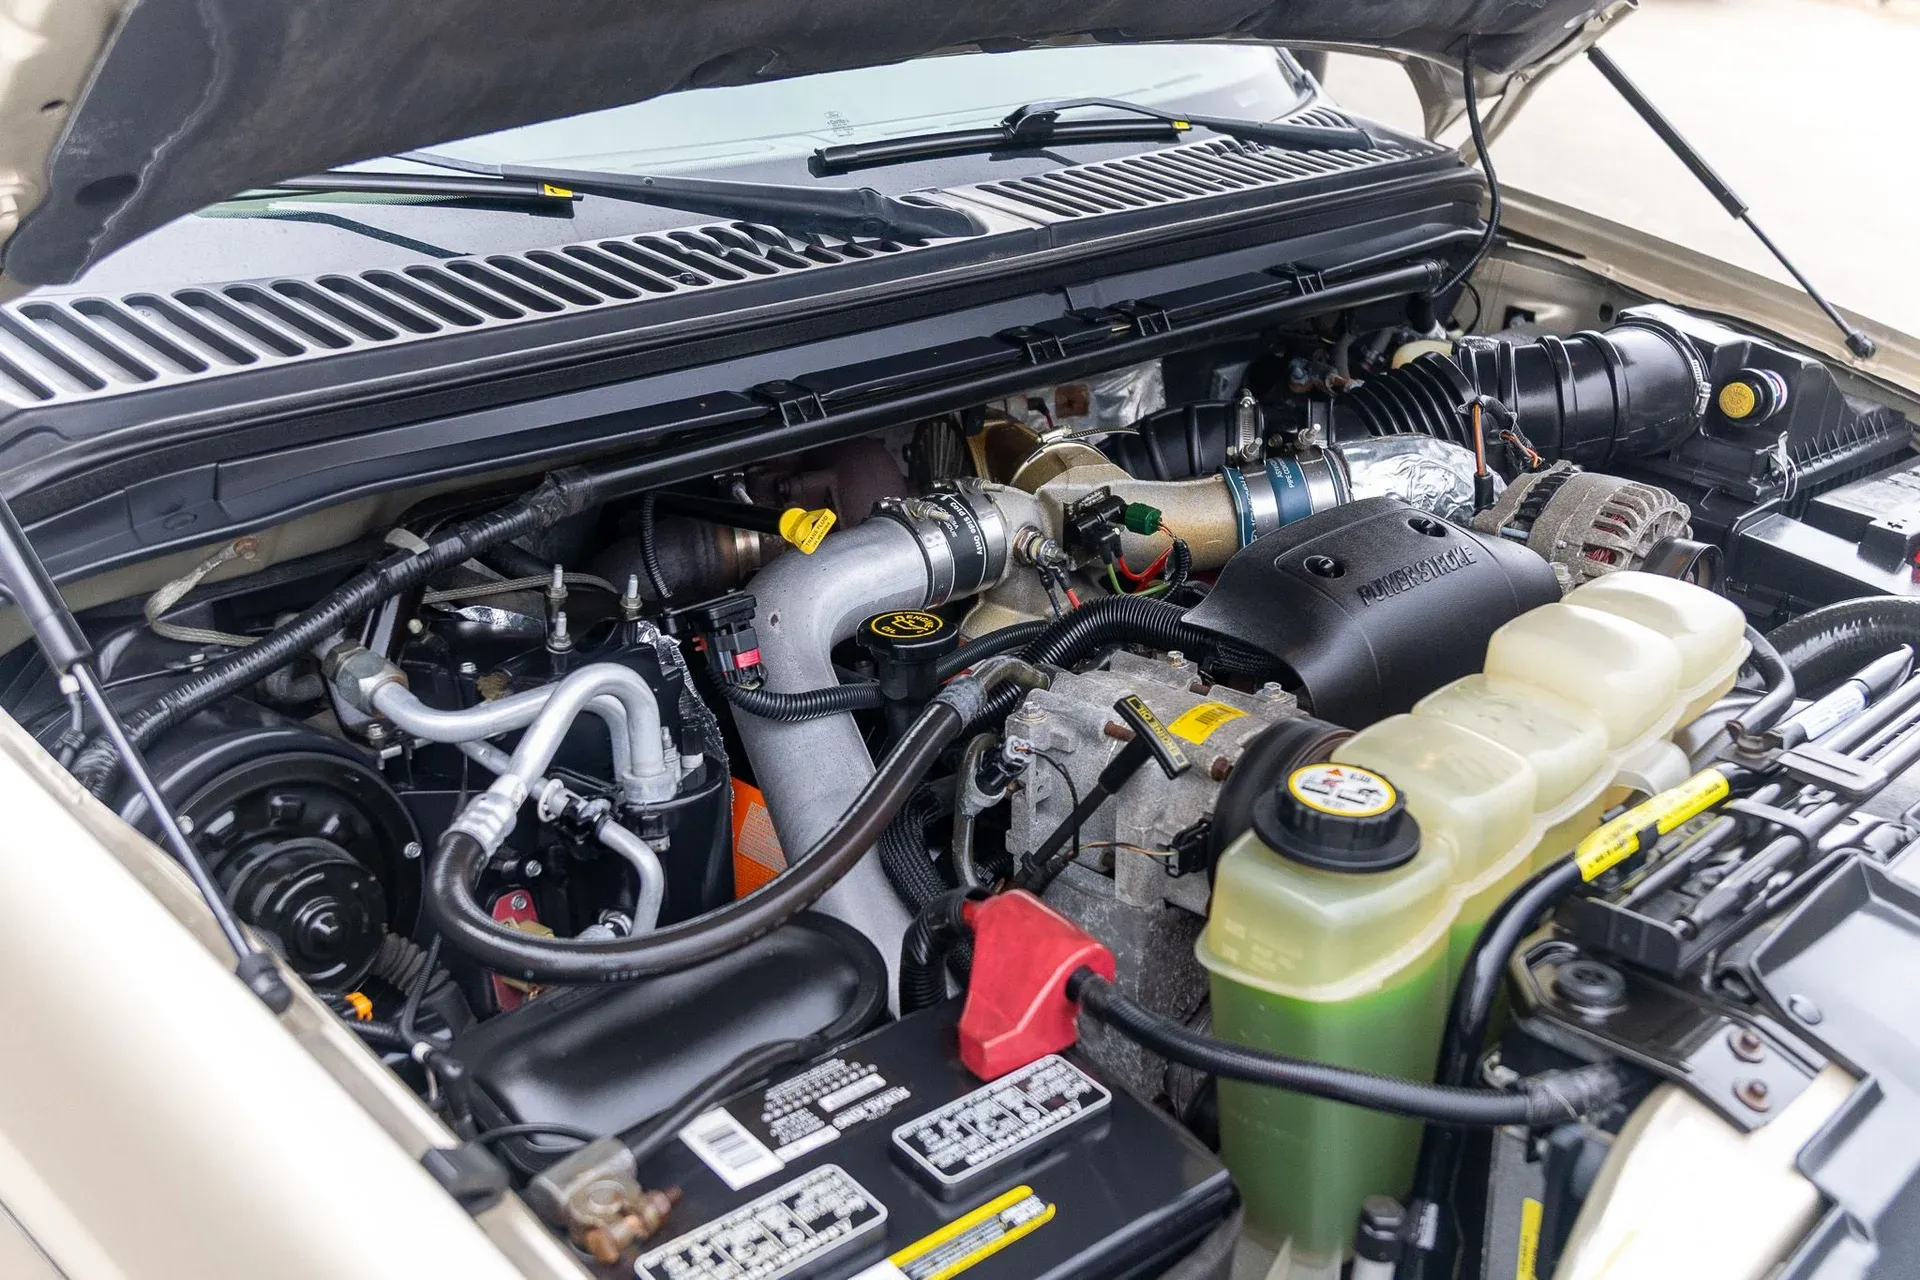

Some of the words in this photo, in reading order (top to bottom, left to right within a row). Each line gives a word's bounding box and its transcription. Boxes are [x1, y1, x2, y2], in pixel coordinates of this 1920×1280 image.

[806, 530, 819, 547] TRANS
[816, 515, 829, 530] FLUID
[950, 502, 966, 516] Cold
[963, 516, 977, 534] Side
[974, 535, 983, 555] Only
[1356, 565, 1420, 607] POWER
[1415, 545, 1477, 582] STROKE
[881, 625, 897, 634] OIL
[905, 614, 935, 629] ENGINE
[1135, 704, 1153, 723] OIL
[1146, 719, 1181, 757] ENGINE
